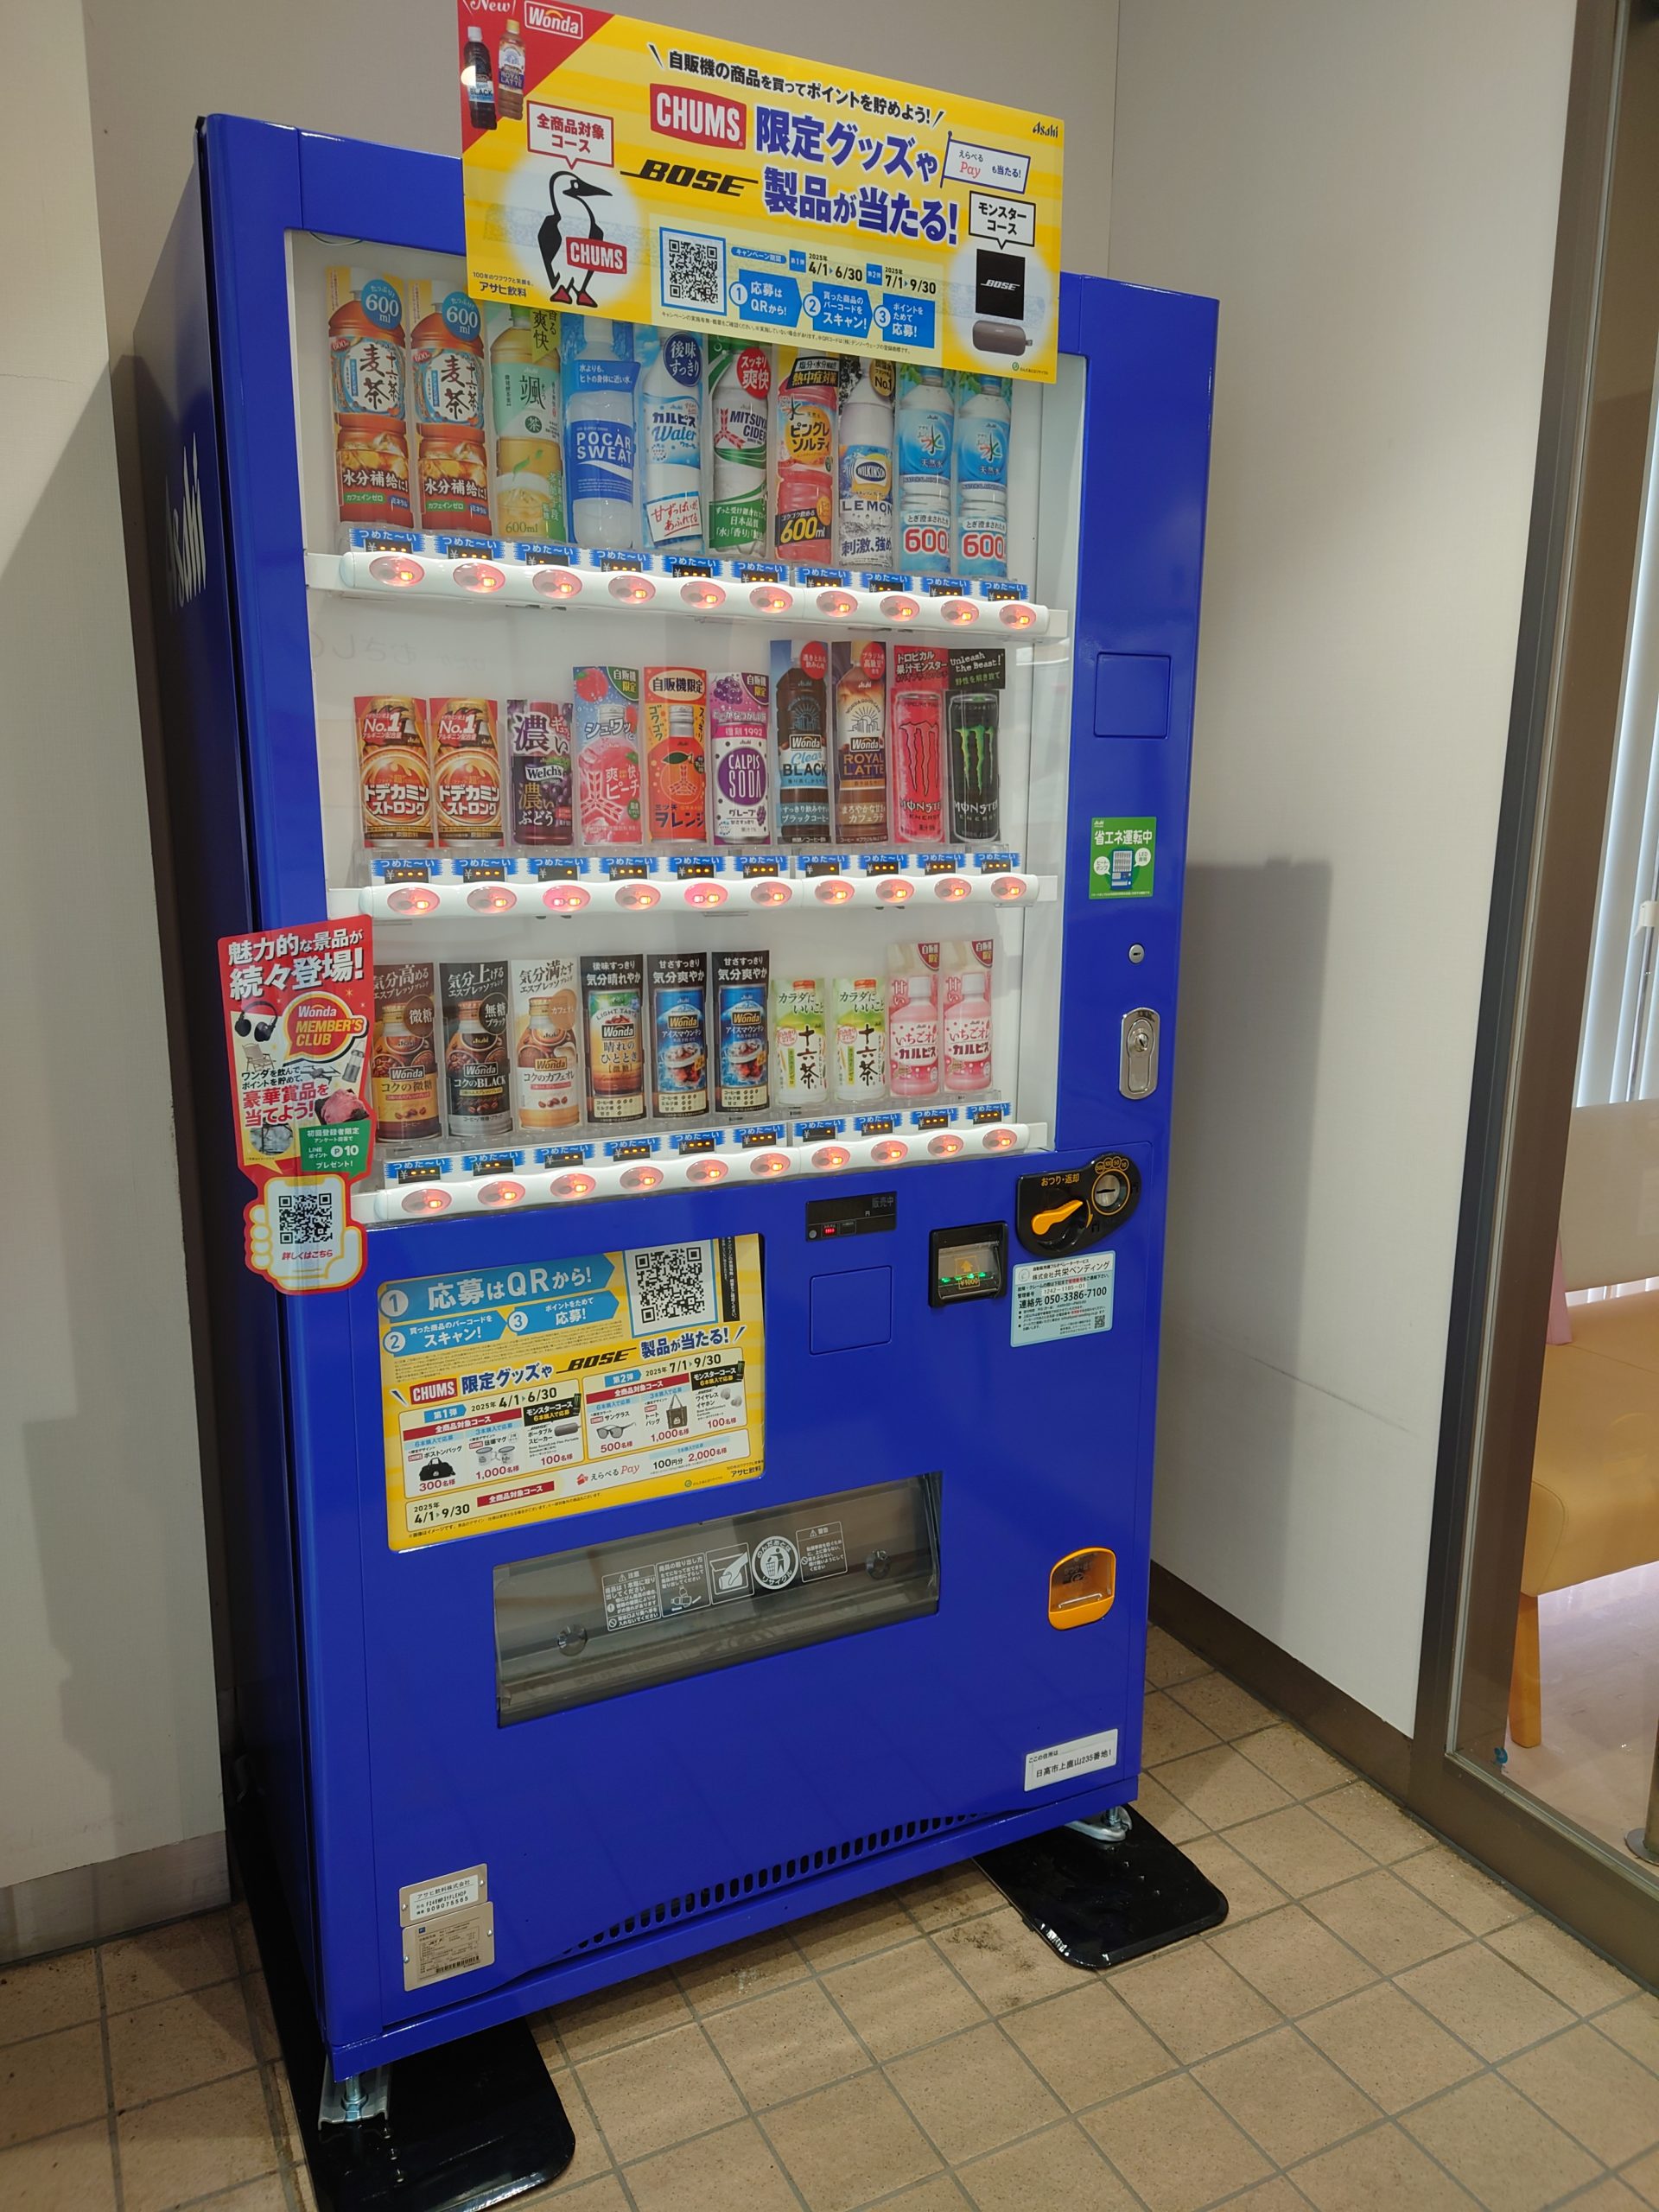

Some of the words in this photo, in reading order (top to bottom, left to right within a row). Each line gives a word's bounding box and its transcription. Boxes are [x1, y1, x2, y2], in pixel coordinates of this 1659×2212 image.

[529, 6, 579, 35] Wonda
[537, 113, 606, 141] 全商品対象
[1033, 121, 1059, 139] Asahi
[551, 135, 592, 155] コース
[655, 92, 742, 143] CHUMS
[756, 105, 939, 182] 限定グッズや
[958, 150, 984, 162] えらべる
[960, 160, 982, 179] Pay
[620, 159, 759, 198] BOSE
[764, 166, 959, 245] 製品が当たる!
[978, 201, 1027, 221] モンスター
[987, 219, 1018, 236] コース
[569, 242, 624, 270] CHUMS
[735, 247, 784, 264] キャンペーン期間
[809, 252, 828, 263] 2025年
[809, 261, 829, 276] 4/1
[835, 264, 863, 283] 6/30
[885, 266, 903, 276] 2025年
[885, 274, 904, 289] 7/1
[910, 278, 937, 296] 9/30
[480, 282, 527, 298] アサヒ飲料
[750, 282, 783, 299] 応募は
[823, 290, 864, 305] 買った商品の
[365, 294, 399, 317] 600
[823, 301, 863, 315] バーコードを
[893, 302, 924, 315] ポイントを
[446, 308, 479, 329] 600
[893, 312, 913, 323] ためて
[671, 340, 696, 359] 後味
[670, 359, 700, 377] すっきり
[741, 355, 767, 368] スッキリ
[359, 343, 390, 410] 麦茶
[742, 369, 769, 391] 爽快
[442, 354, 471, 420] 麦茶
[652, 411, 696, 429] カルピス
[652, 425, 697, 442] Water
[577, 445, 632, 464] SWEAT
[346, 493, 384, 503] カフェインゼロ
[505, 520, 539, 533] 600ml
[897, 651, 935, 663] トロピカル
[950, 651, 986, 667] Unleash
[896, 662, 948, 675] 果汁モンスター
[955, 662, 972, 672] the
[613, 670, 637, 682] 自販機
[621, 681, 637, 692] 限定
[652, 676, 703, 694] 自販機限定
[791, 736, 821, 749] Wonda
[728, 753, 760, 771] CALPIS
[843, 753, 884, 765] ROYAL
[783, 763, 827, 777] BLACK
[843, 764, 885, 776] LATTE
[606, 779, 640, 800] ピーチ
[728, 770, 762, 799] SODA
[364, 784, 429, 802] ドデカミン
[439, 785, 499, 802] ドデカミン
[372, 801, 425, 816] ストロング
[447, 802, 497, 816] ストロング
[518, 810, 554, 826] ぶどう
[1094, 830, 1153, 846] 省エネ運転中
[227, 928, 364, 966] 魅力的な景品が
[519, 959, 575, 984] 気分満たす
[592, 960, 636, 972] 後味すっきり
[659, 958, 700, 969] 甘さすっきり
[448, 963, 505, 989] 気分上げる
[586, 972, 641, 986] 気分晴れやか
[652, 969, 705, 984] 気分爽やか
[718, 967, 767, 982] 気分爽やか
[779, 992, 816, 1004] カラダに
[839, 991, 876, 1003] カラダに
[409, 1007, 433, 1024] 微糖
[484, 1002, 506, 1018] 無糖
[295, 1018, 364, 1034] MEMBER'S
[296, 1033, 332, 1047] CLUB
[603, 1041, 635, 1052] 晴れの
[601, 1052, 638, 1065] ひととき
[454, 1075, 506, 1089] コクのBLACK
[243, 1082, 329, 1109] 豪華賞品を
[307, 1127, 360, 1138] 初回登録者限定
[344, 1145, 359, 1157] 10
[1040, 1173, 1080, 1187] おつり・返却
[282, 1249, 334, 1262] 詳しくはこちら
[1032, 1261, 1110, 1281] 株式会社共栄ベンディング
[544, 1297, 594, 1313] ポイントをためて
[1020, 1297, 1043, 1309] 連絡先
[1044, 1286, 1107, 1306] 050-3386-7100
[412, 1382, 456, 1403] CHUMS
[461, 1363, 553, 1395] 限定グッズや
[556, 1347, 638, 1375] BOSE
[433, 1408, 458, 1421] 第1弾
[470, 1401, 497, 1412] 2025年
[499, 1395, 520, 1408] 4/1
[527, 1387, 558, 1403] 6/30
[526, 1401, 574, 1417] モンスターコース
[605, 1410, 631, 1421] サングラス
[600, 1440, 633, 1453] 500名様
[540, 1453, 574, 1466] 100名様
[652, 1457, 683, 1471] 100円分
[418, 1478, 456, 1492] 300名様
[761, 1569, 792, 1586] リサイクル
[1028, 1750, 1058, 1764] ここの住所は
